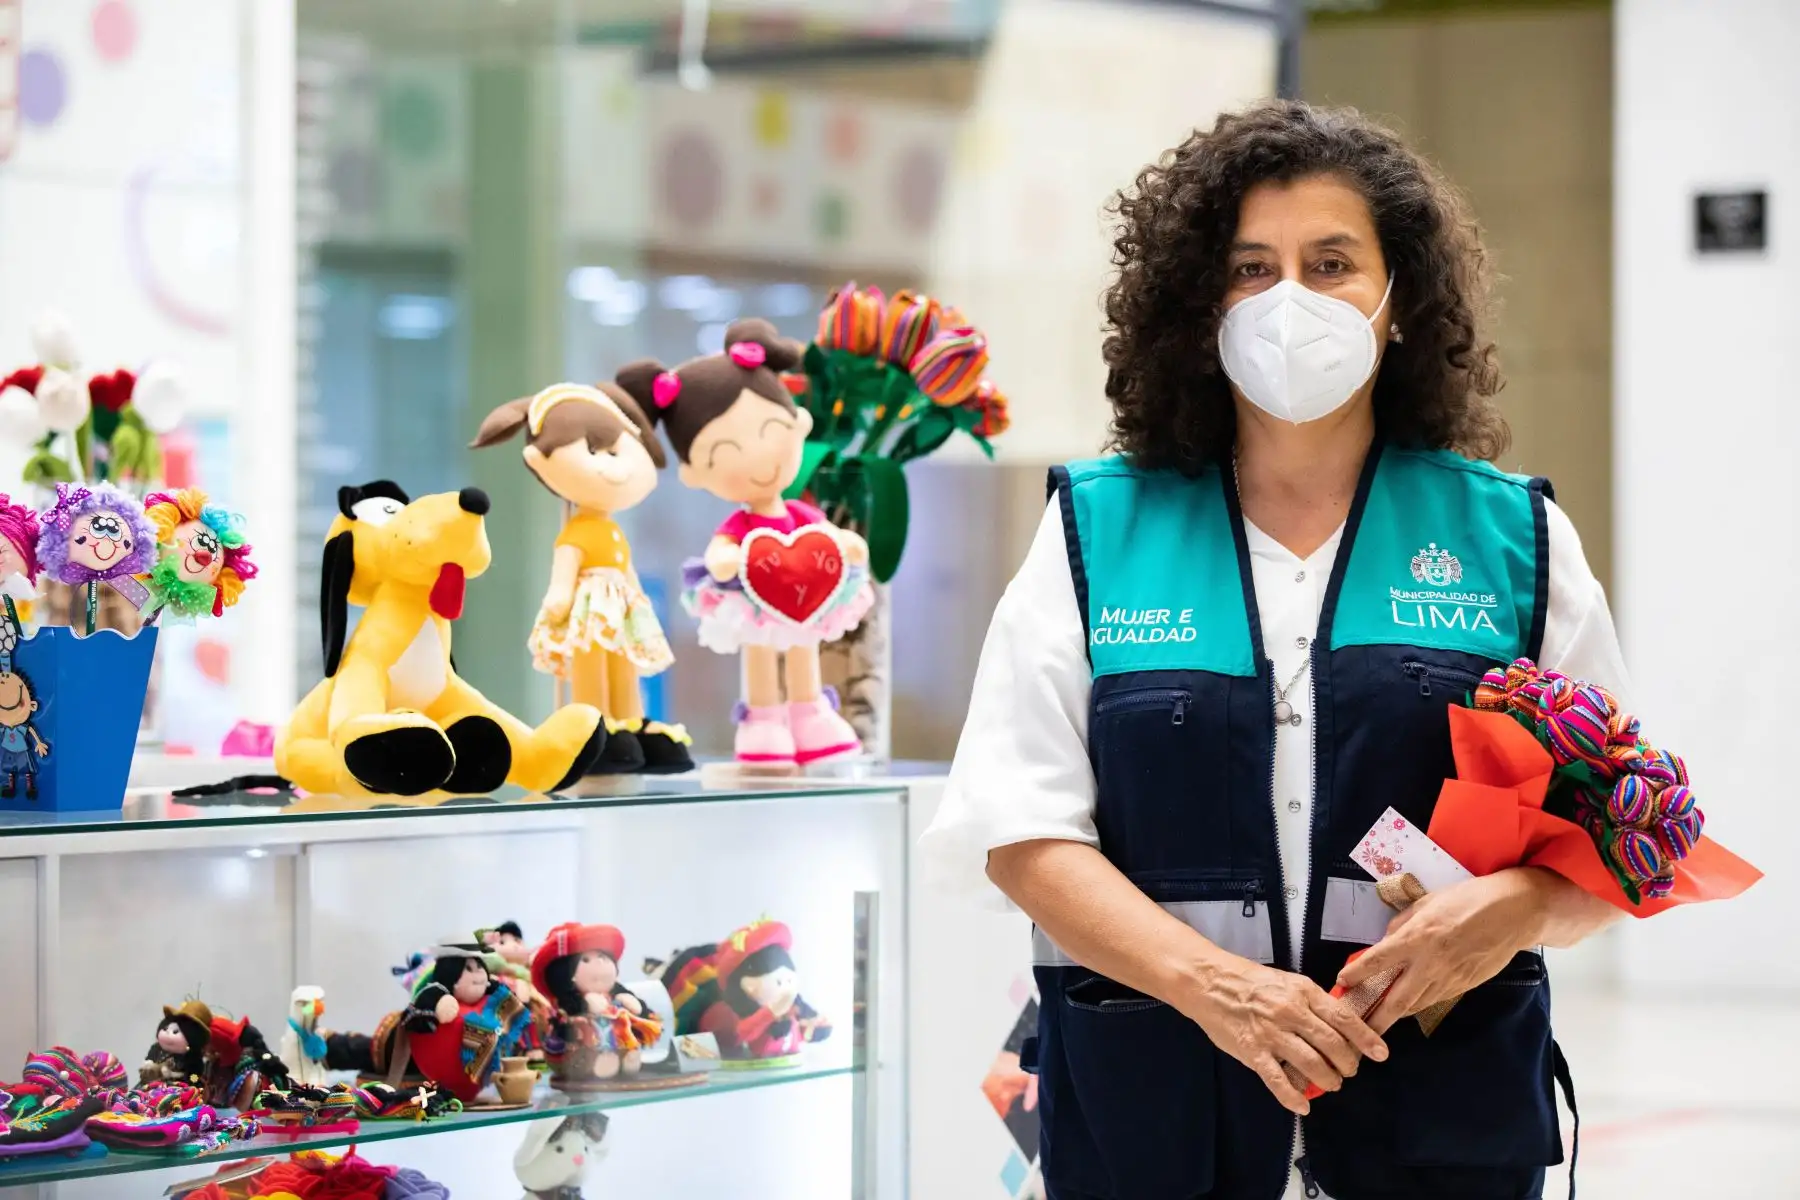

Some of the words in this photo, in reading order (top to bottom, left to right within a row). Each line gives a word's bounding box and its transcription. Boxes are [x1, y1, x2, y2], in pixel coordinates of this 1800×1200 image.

[812, 550, 839, 575] YO
[793, 583, 808, 608] Y
[1390, 586, 1478, 603] MUNICIPALIDAD
[1480, 594, 1497, 603] DE
[1100, 607, 1171, 625] MUJER
[1179, 608, 1194, 624] E
[1391, 600, 1500, 636] LIMA
[1090, 627, 1197, 646] IGUALDAD
